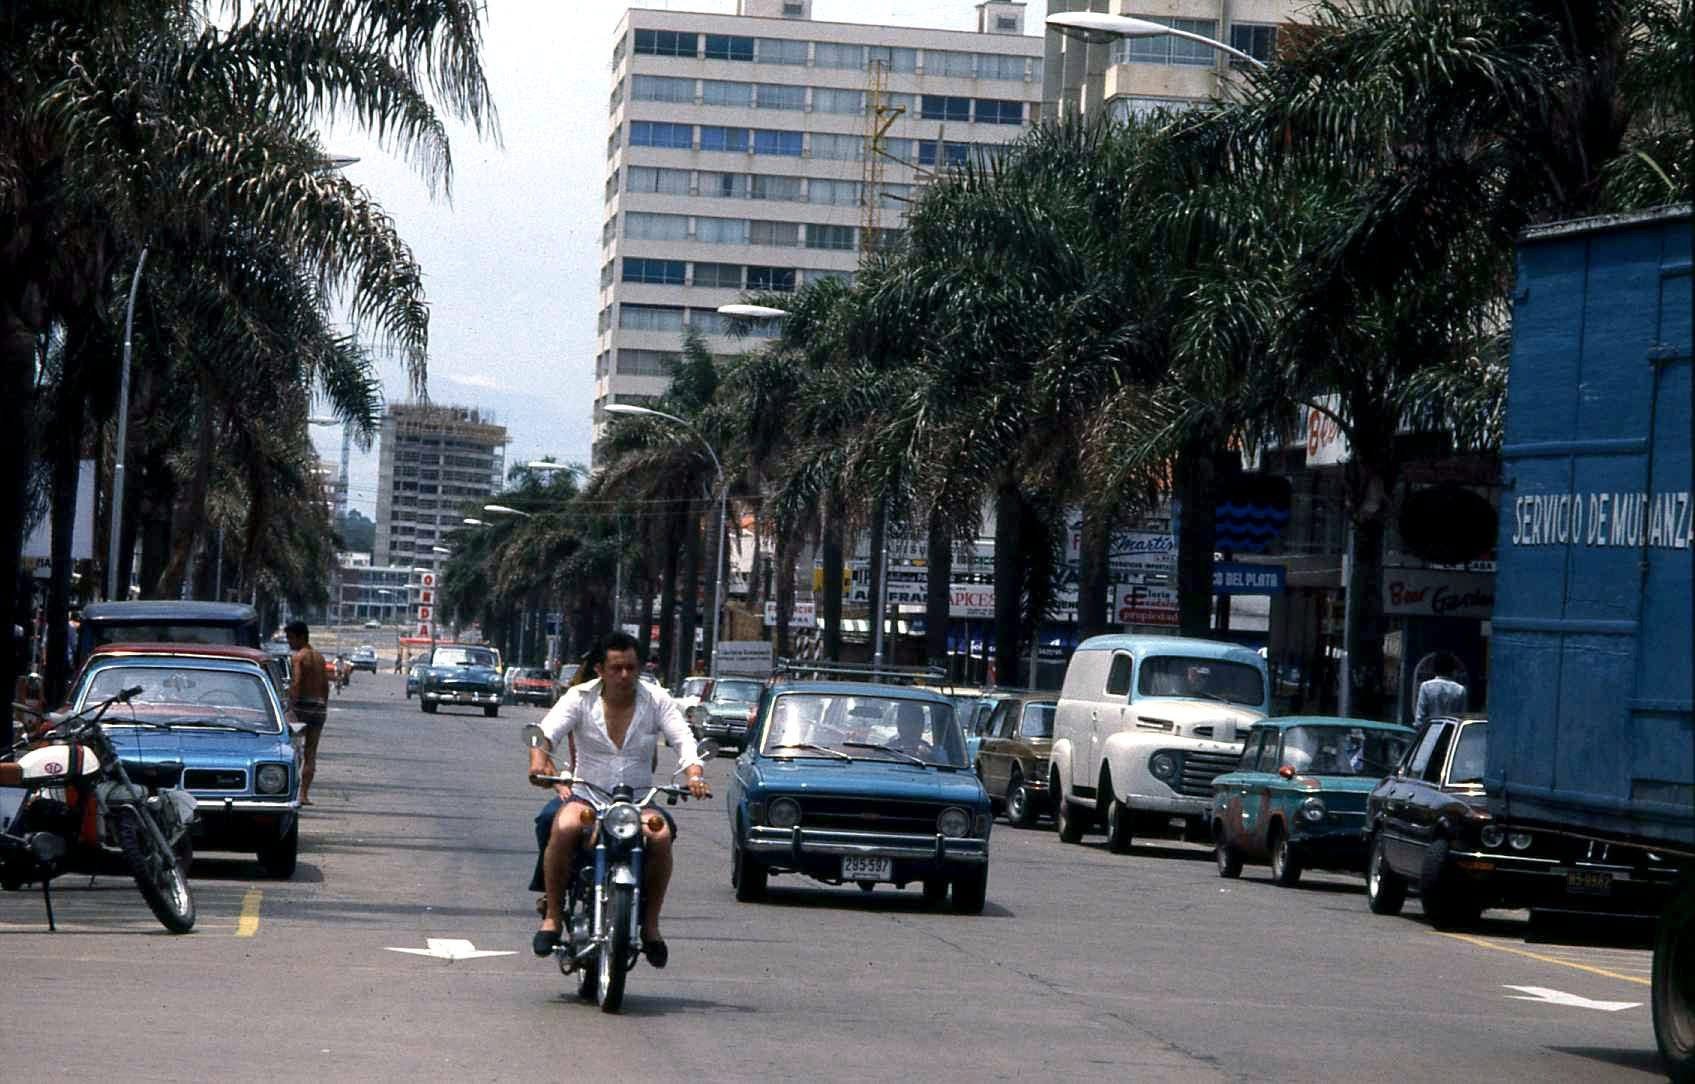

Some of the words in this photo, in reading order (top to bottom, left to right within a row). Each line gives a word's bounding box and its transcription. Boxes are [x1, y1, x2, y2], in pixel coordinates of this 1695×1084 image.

[1513, 494, 1582, 545] SERVICIO
[1587, 492, 1610, 546] DE
[1224, 571, 1244, 587] DEL
[1245, 571, 1279, 588] PLATA
